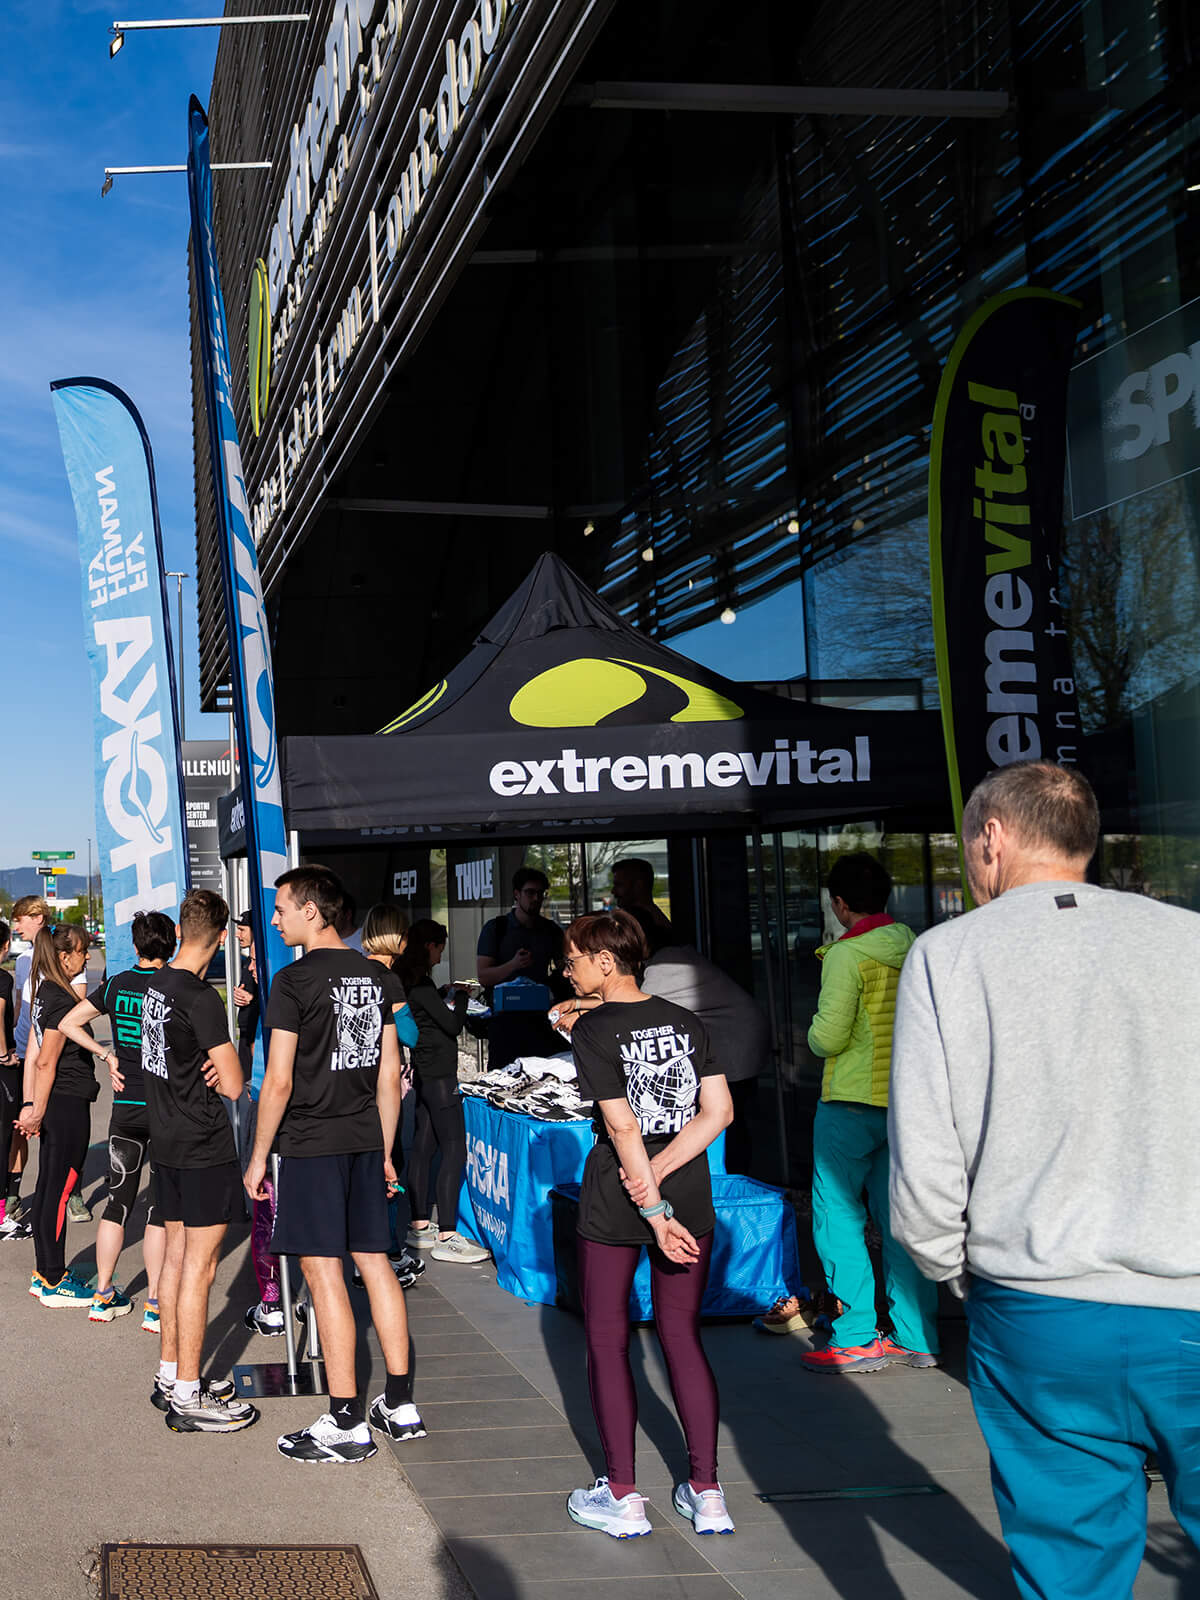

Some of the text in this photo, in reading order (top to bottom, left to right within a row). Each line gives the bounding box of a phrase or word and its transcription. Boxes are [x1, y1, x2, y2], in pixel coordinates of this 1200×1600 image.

[268, 0, 376, 317] extrem
[287, 381, 313, 478] ski
[327, 285, 362, 393] run
[182, 759, 241, 777] ILLENIU
[489, 735, 871, 795] extremevital
[455, 858, 494, 901] THULE
[332, 985, 382, 1005] WE FLY
[340, 976, 373, 986] TOGETHER
[631, 1025, 675, 1040] TOGETHER
[620, 1033, 690, 1062] WE FLY
[465, 1131, 510, 1212] HOKA
[56, 1287, 75, 1298] HOKA
